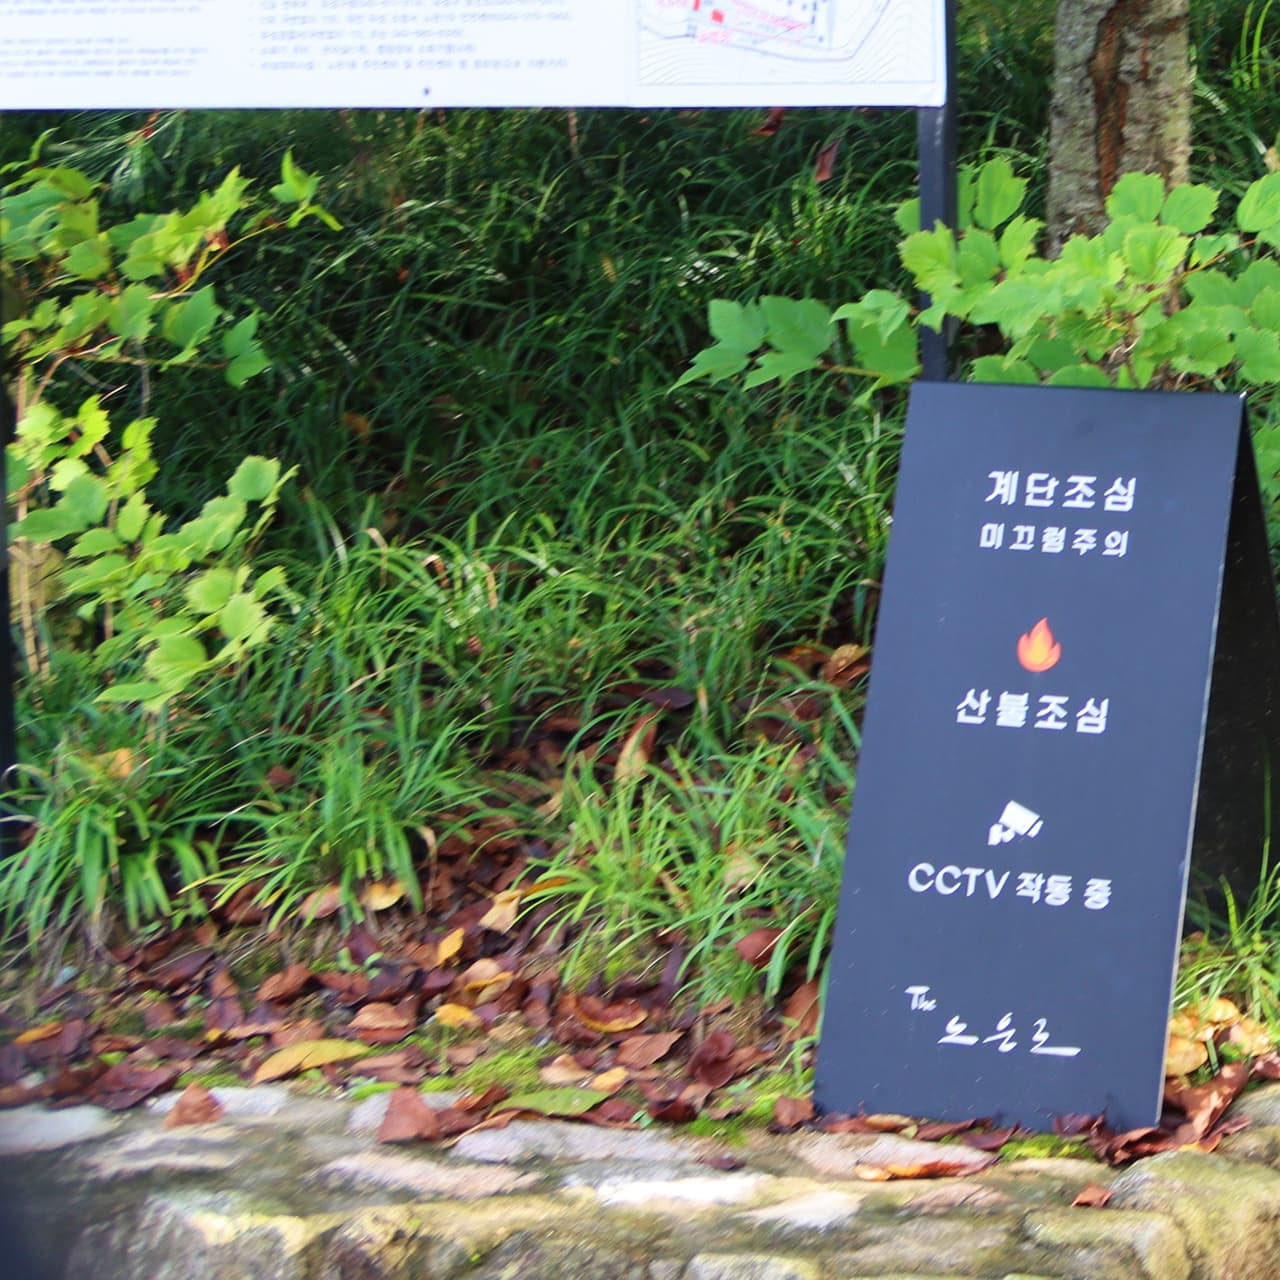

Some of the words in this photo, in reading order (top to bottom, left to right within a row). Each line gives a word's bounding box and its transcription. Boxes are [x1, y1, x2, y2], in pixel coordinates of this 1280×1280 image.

[984, 470, 1136, 512] 계단조심
[978, 523, 1129, 558] 미끄럼주의
[956, 688, 1109, 734] 산불조심
[908, 862, 1010, 900] CCTV
[1015, 872, 1073, 906] 작동
[1083, 878, 1113, 910] 중
[904, 985, 938, 1012] The
